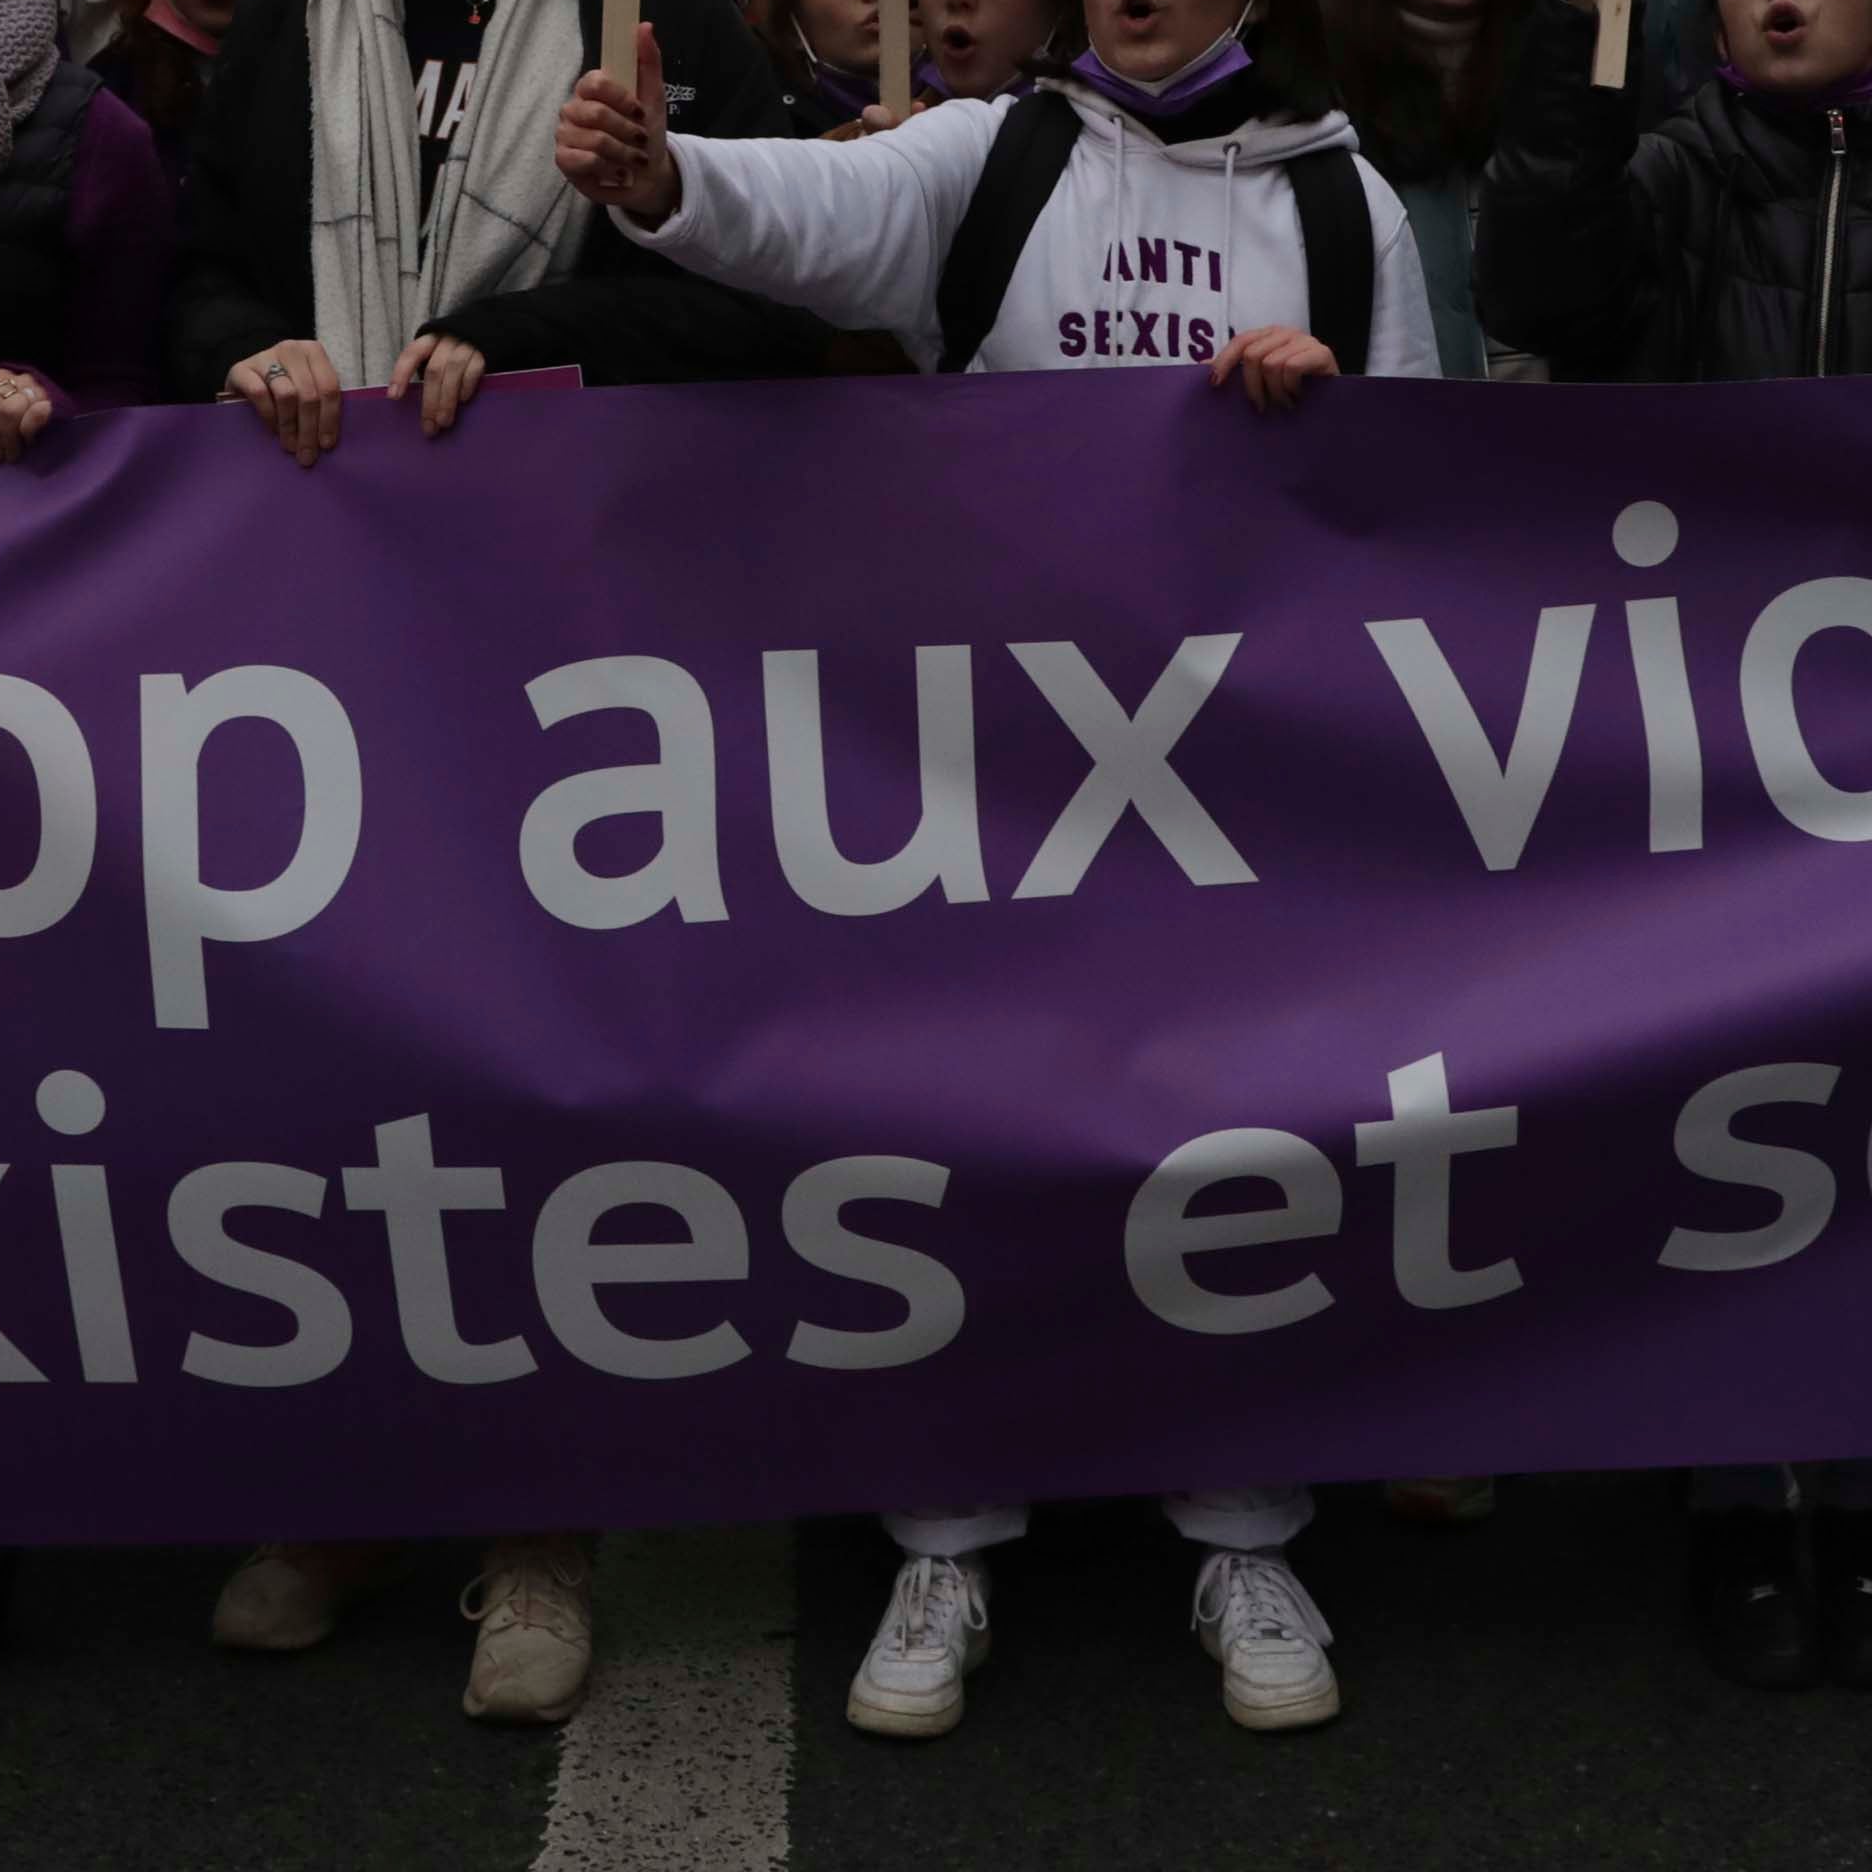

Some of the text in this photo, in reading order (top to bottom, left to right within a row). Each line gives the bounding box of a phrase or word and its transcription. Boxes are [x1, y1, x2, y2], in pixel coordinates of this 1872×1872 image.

[1059, 310, 1235, 363] SEXIS
[1103, 236, 1221, 292] ANTI
[518, 632, 1260, 930] aux
[1124, 1051, 1524, 1337] et
